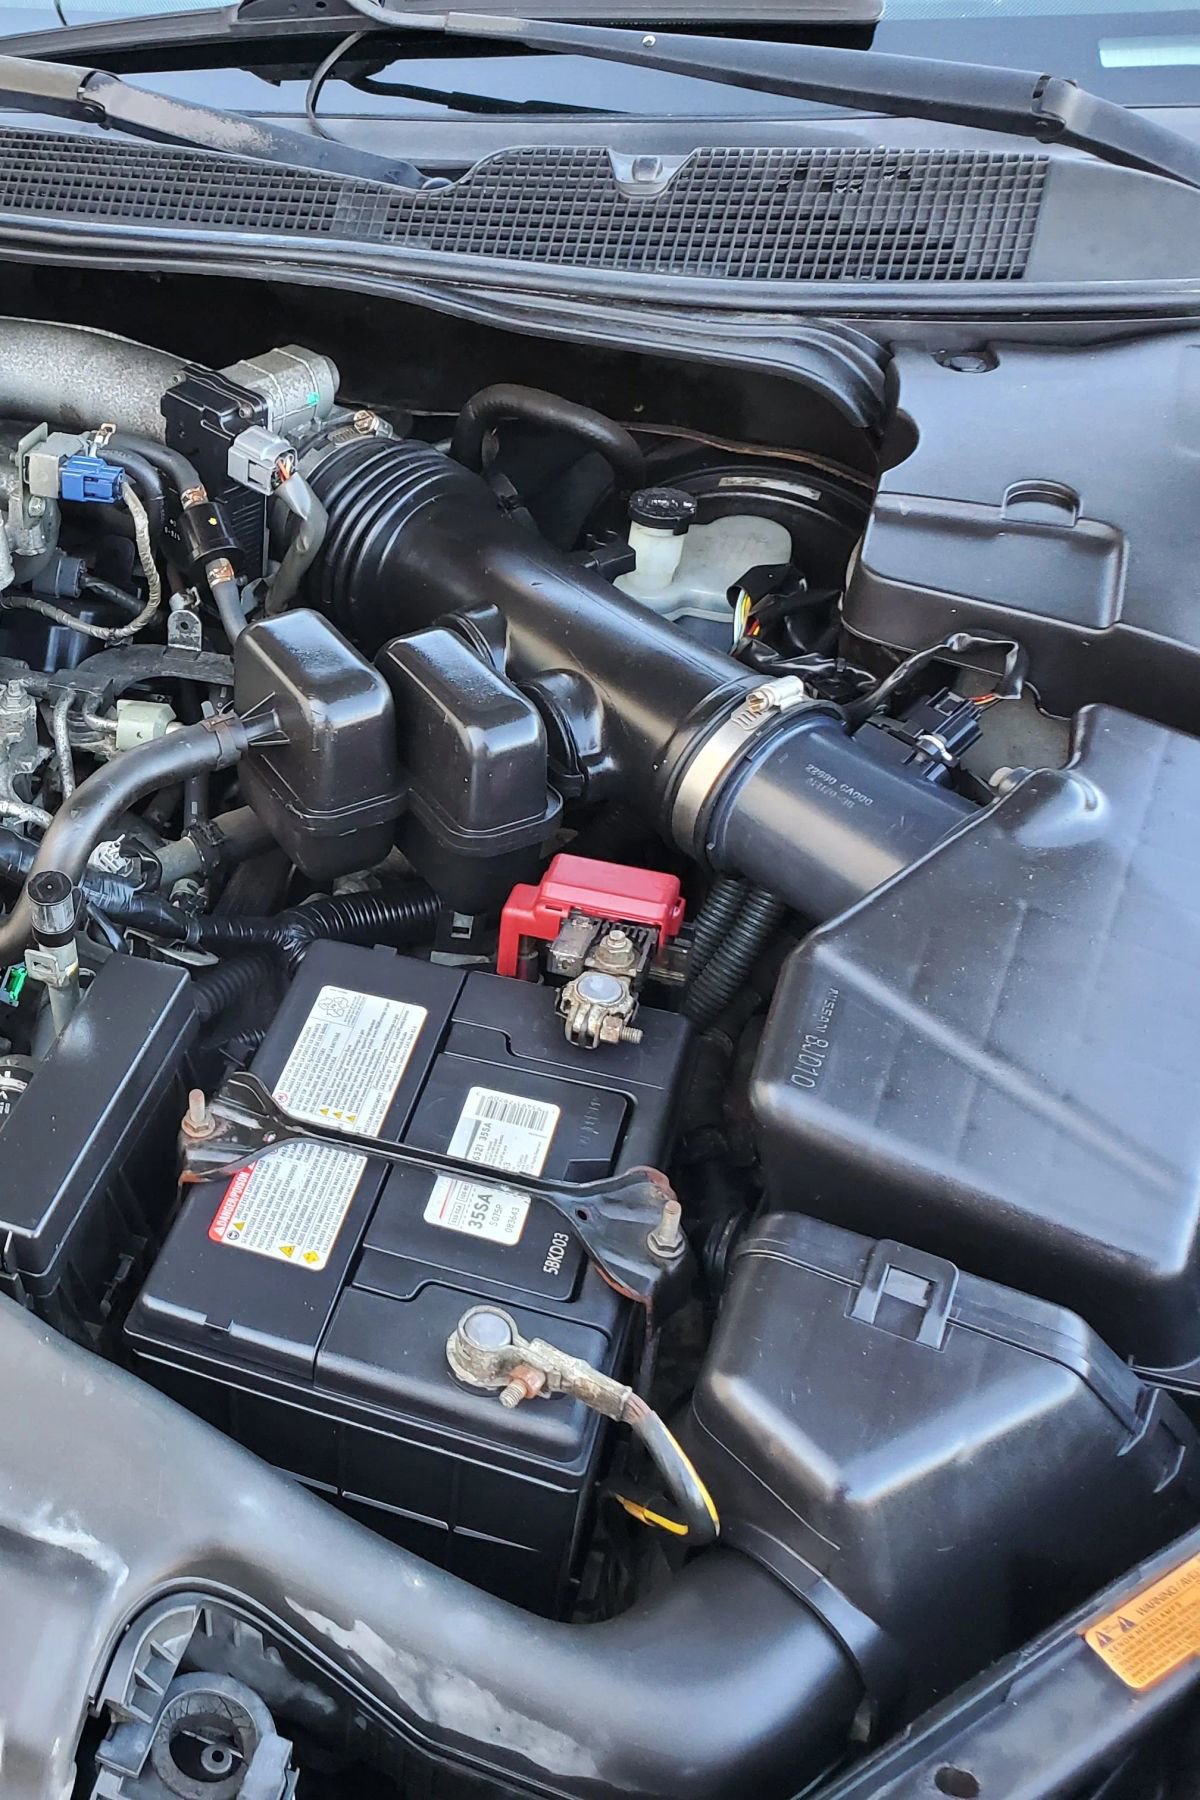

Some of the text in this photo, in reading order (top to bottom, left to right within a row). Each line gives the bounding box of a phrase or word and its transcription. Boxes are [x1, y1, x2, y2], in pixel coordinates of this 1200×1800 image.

[814, 987, 839, 1033] NISSAN
[216, 1170, 249, 1230] DANGER/POISON
[468, 1193, 493, 1229] 35SA
[543, 1232, 569, 1275] 5BKD03
